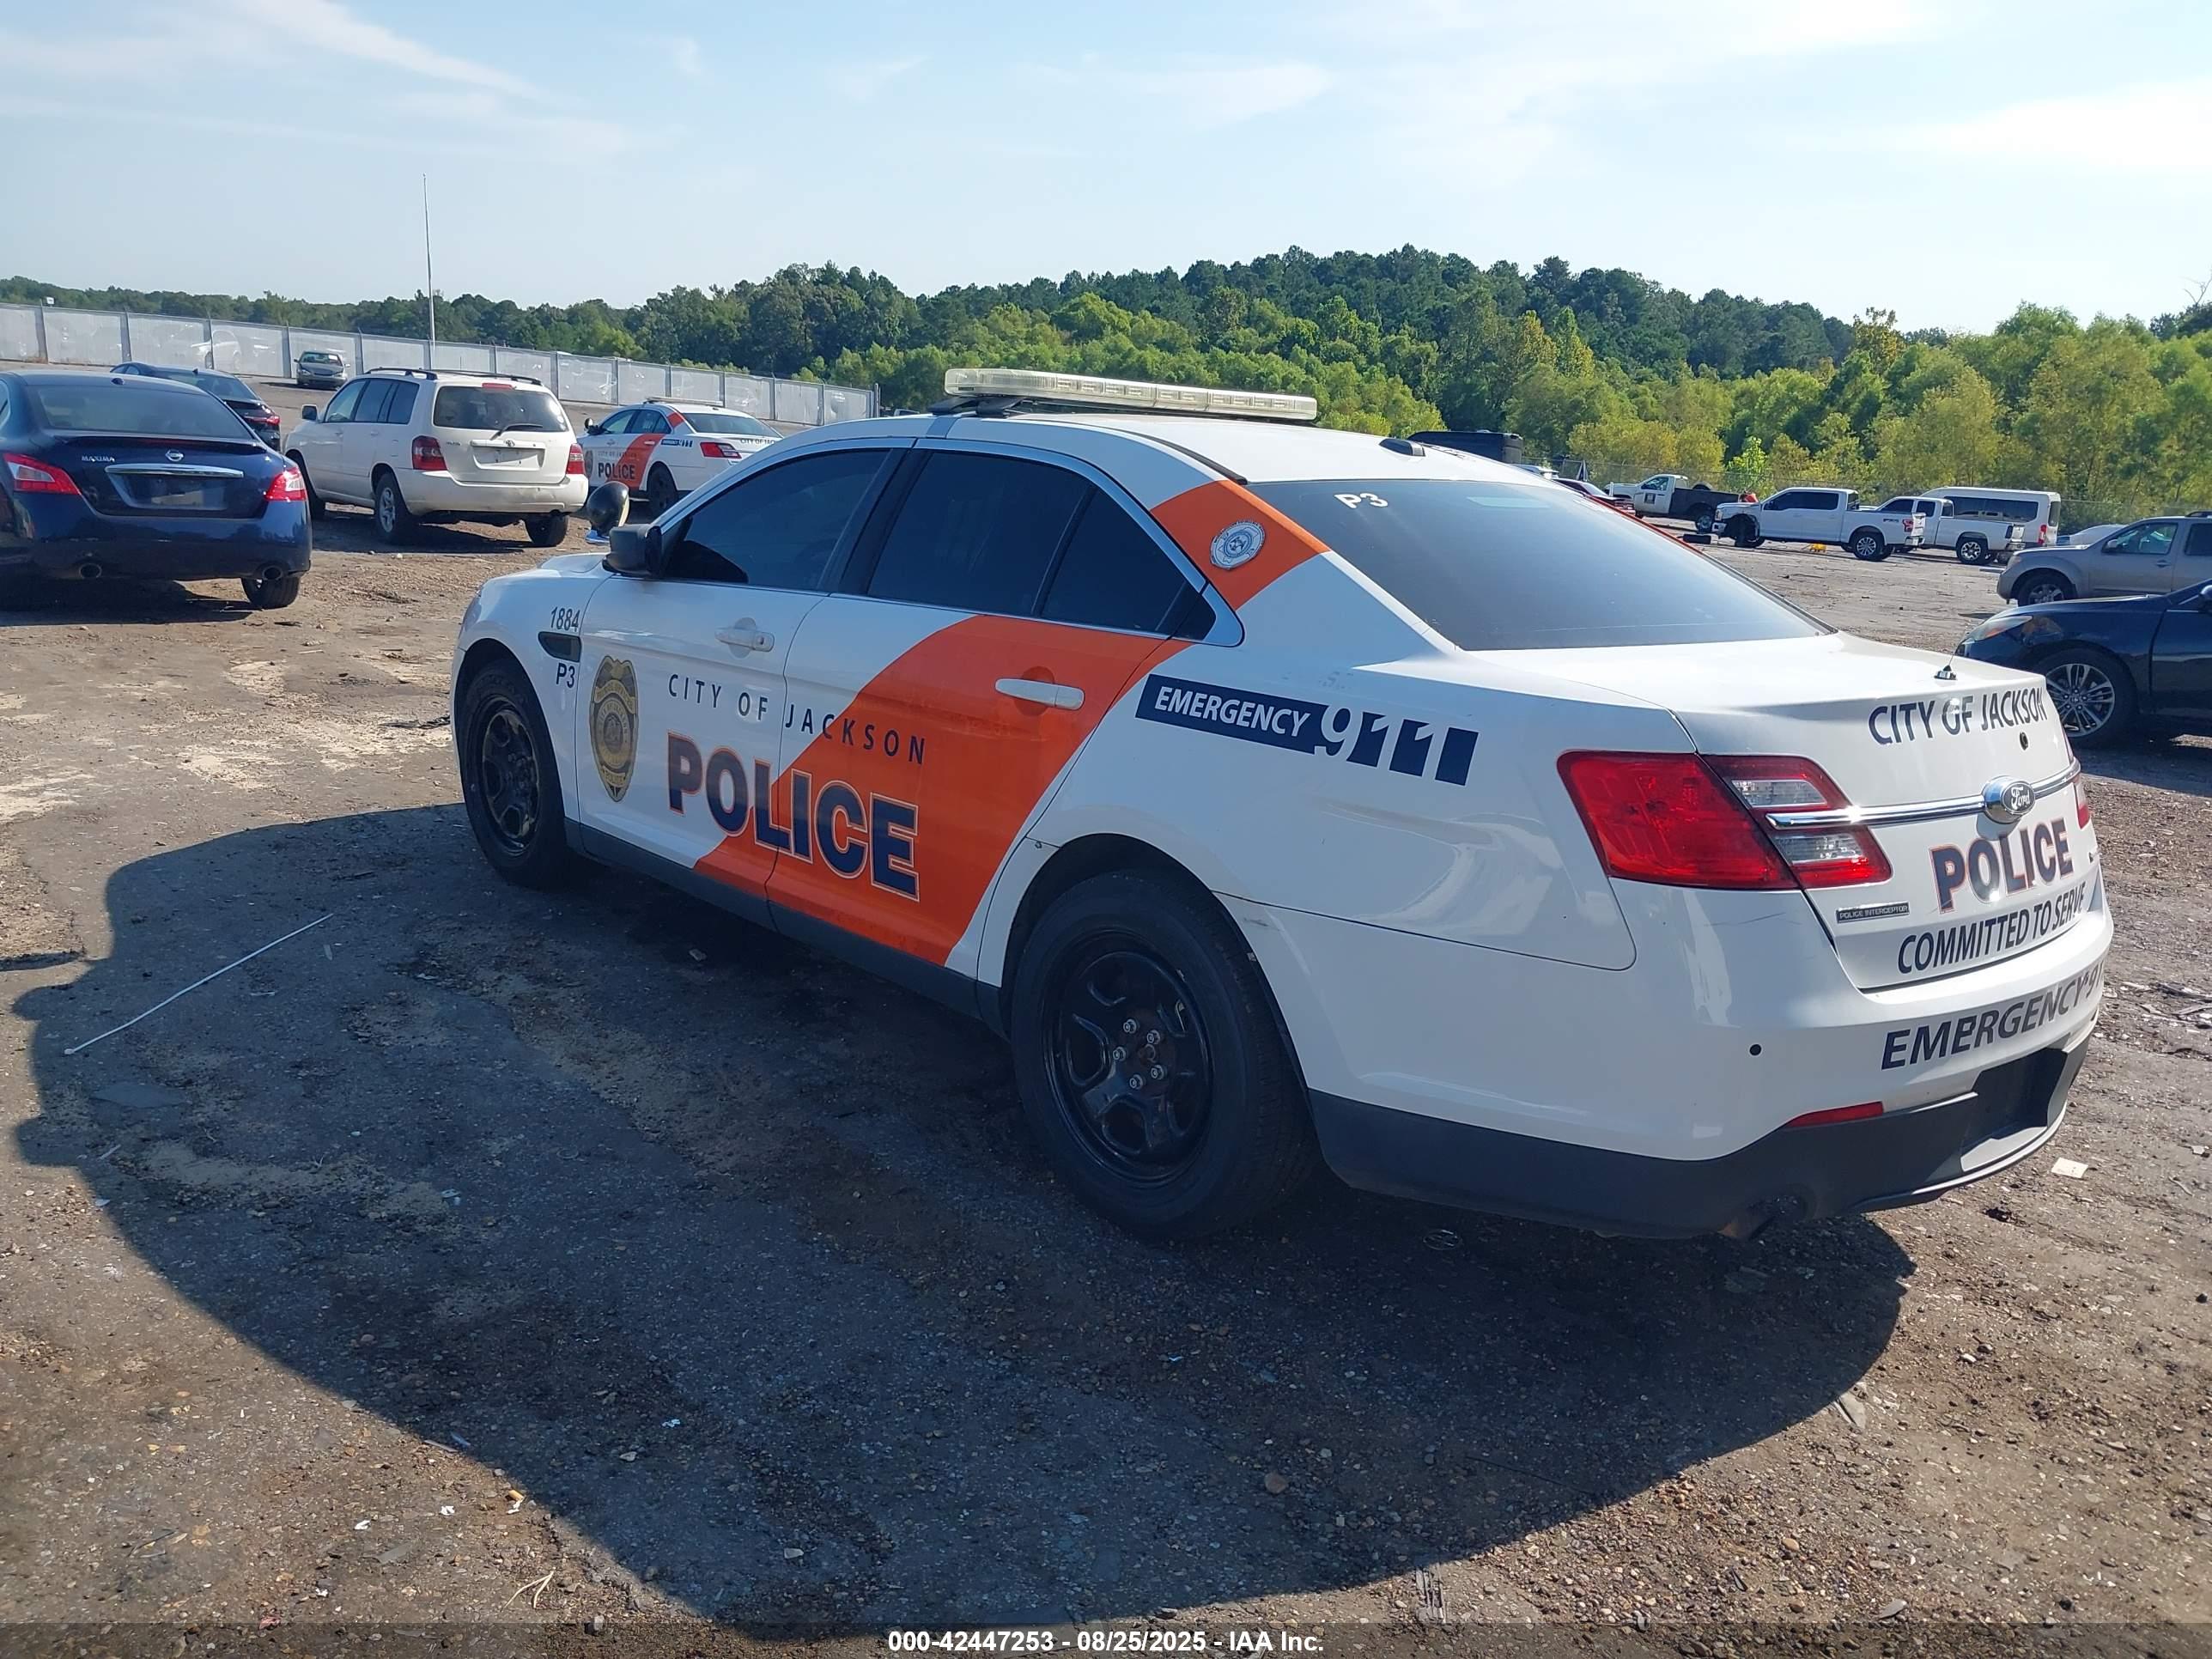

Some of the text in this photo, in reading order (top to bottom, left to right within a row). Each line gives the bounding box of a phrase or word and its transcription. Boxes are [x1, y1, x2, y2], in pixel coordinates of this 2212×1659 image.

[598, 462, 636, 480] POLICE
[1334, 492, 1389, 509] P3
[550, 606, 580, 633] 1884
[556, 661, 575, 689] P3
[668, 672, 723, 709] CITY
[738, 692, 769, 722] OF
[785, 702, 927, 766] JACKSON
[1154, 686, 1451, 781] EMERGENCY 911
[1868, 686, 2049, 745] CITY OF JACKSON
[666, 730, 921, 903] POLICE
[2010, 785, 2032, 810] Ford
[1929, 817, 2075, 915] POLICE
[1839, 904, 1908, 920] POLICE INTERCEPTOR
[1898, 881, 2086, 975] COMMITTED TO SERVE
[1881, 975, 2082, 1071] EMERGENCY
